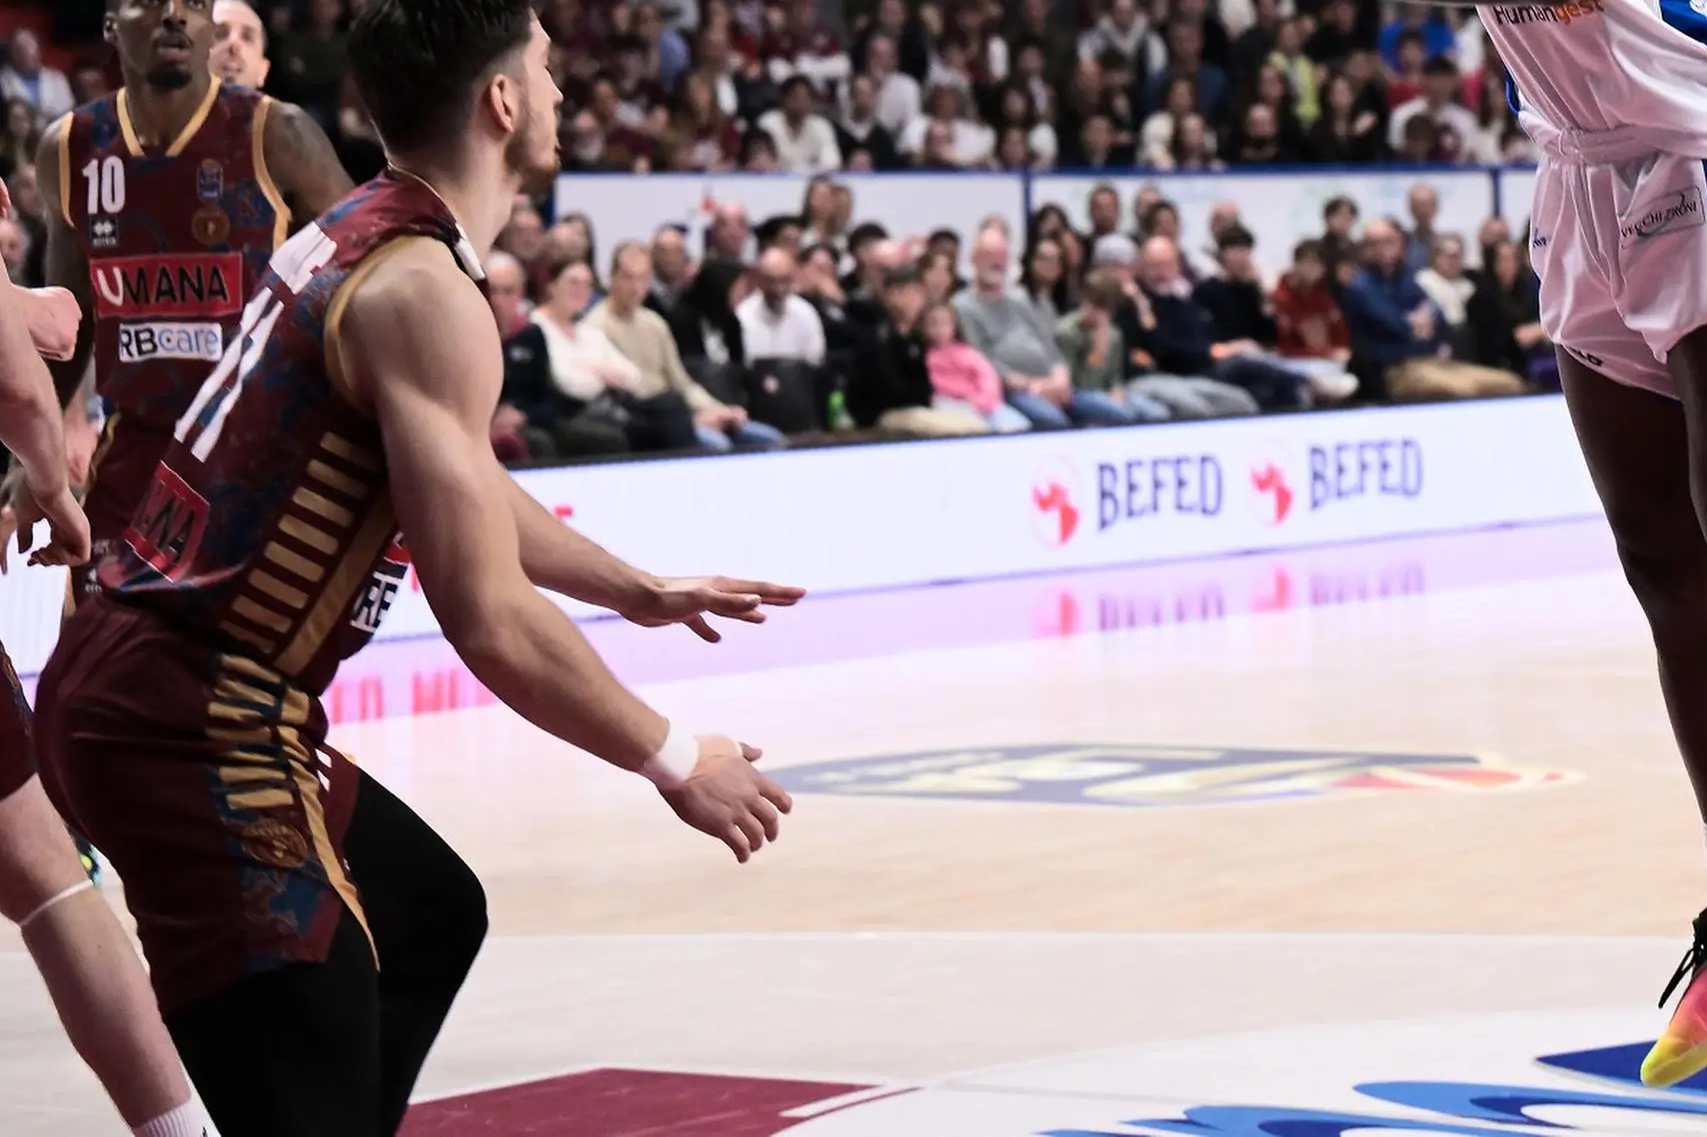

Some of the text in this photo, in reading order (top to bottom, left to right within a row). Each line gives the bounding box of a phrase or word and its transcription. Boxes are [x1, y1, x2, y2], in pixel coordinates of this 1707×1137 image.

[82, 155, 126, 215] 10
[96, 266, 230, 307] UMANA
[1098, 456, 1223, 531] BEFED
[1309, 439, 1423, 510] BEFED
